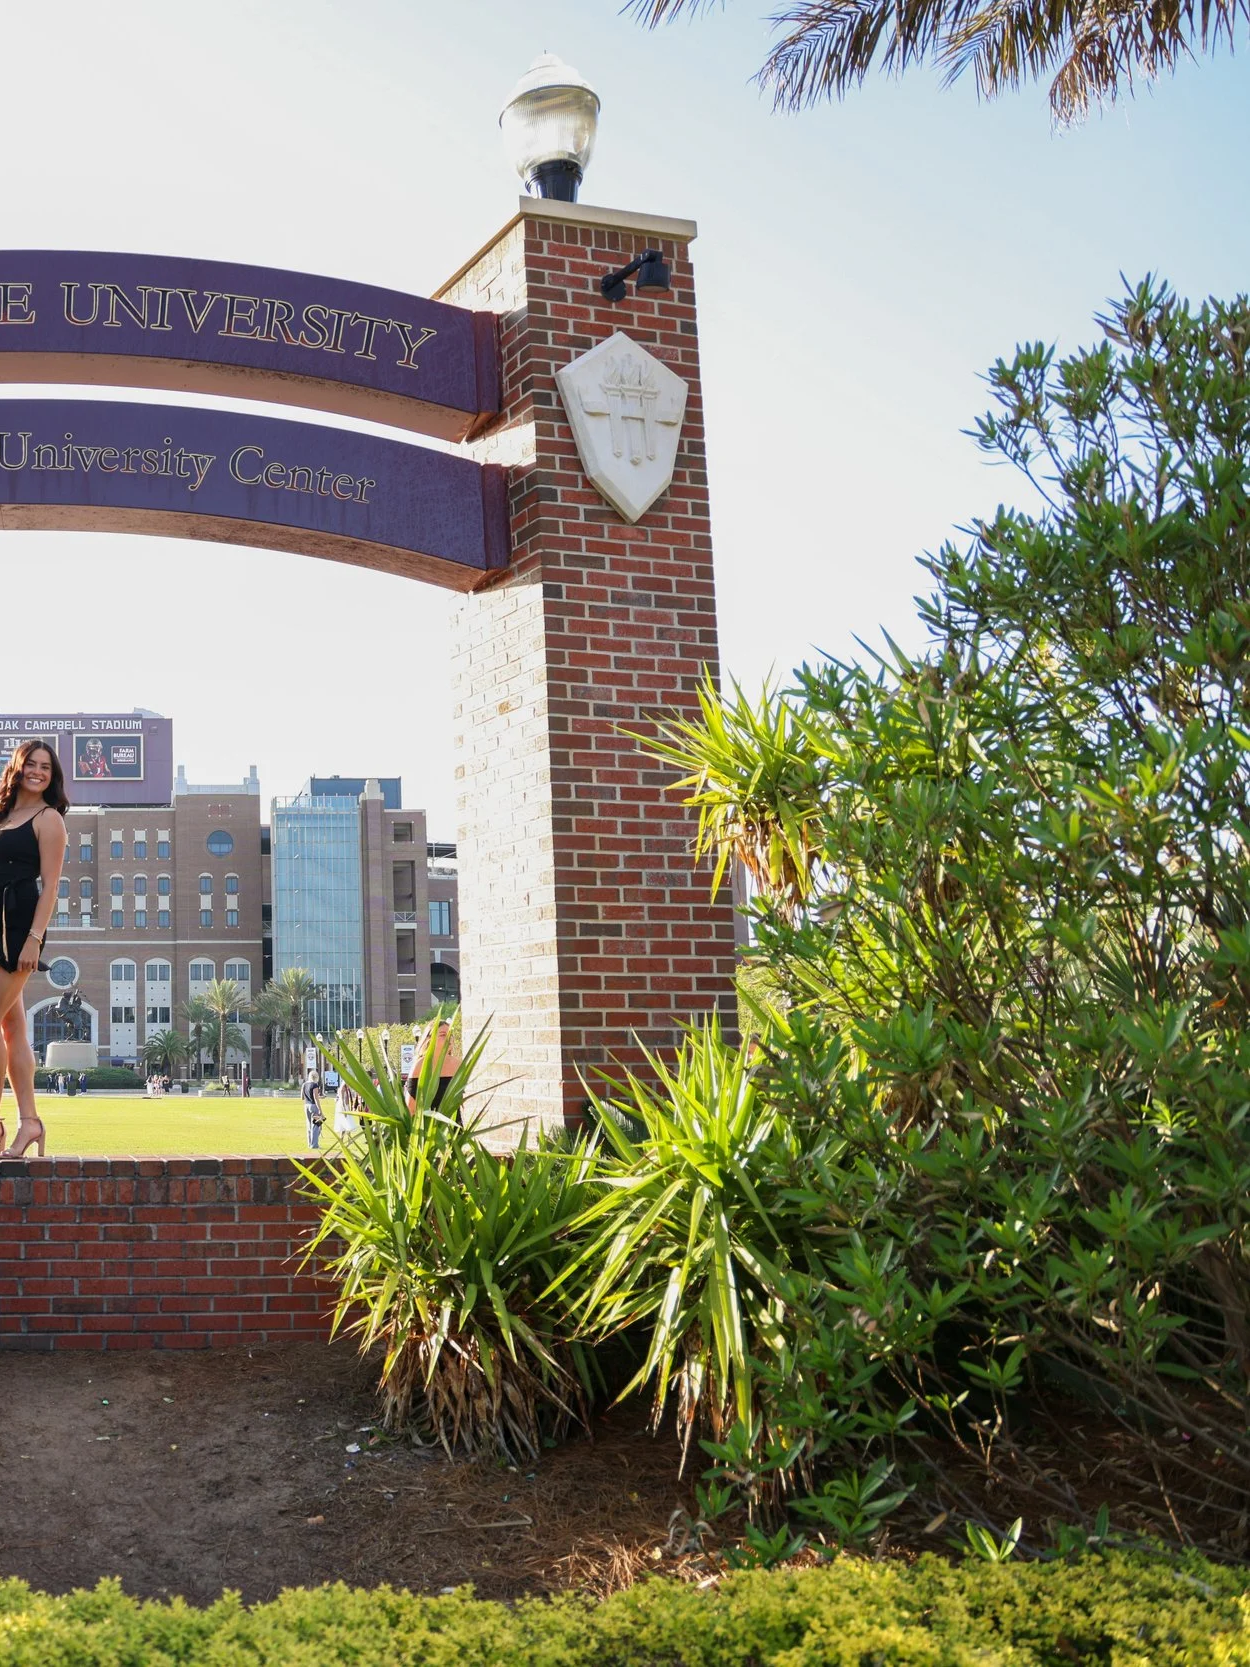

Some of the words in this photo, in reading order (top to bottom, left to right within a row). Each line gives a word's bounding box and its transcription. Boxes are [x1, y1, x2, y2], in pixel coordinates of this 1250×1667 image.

[60, 282, 437, 370] UNIVERSITY
[228, 445, 376, 504] Center
[24, 720, 86, 730] CAMPBELL
[91, 720, 143, 730] STADIUM
